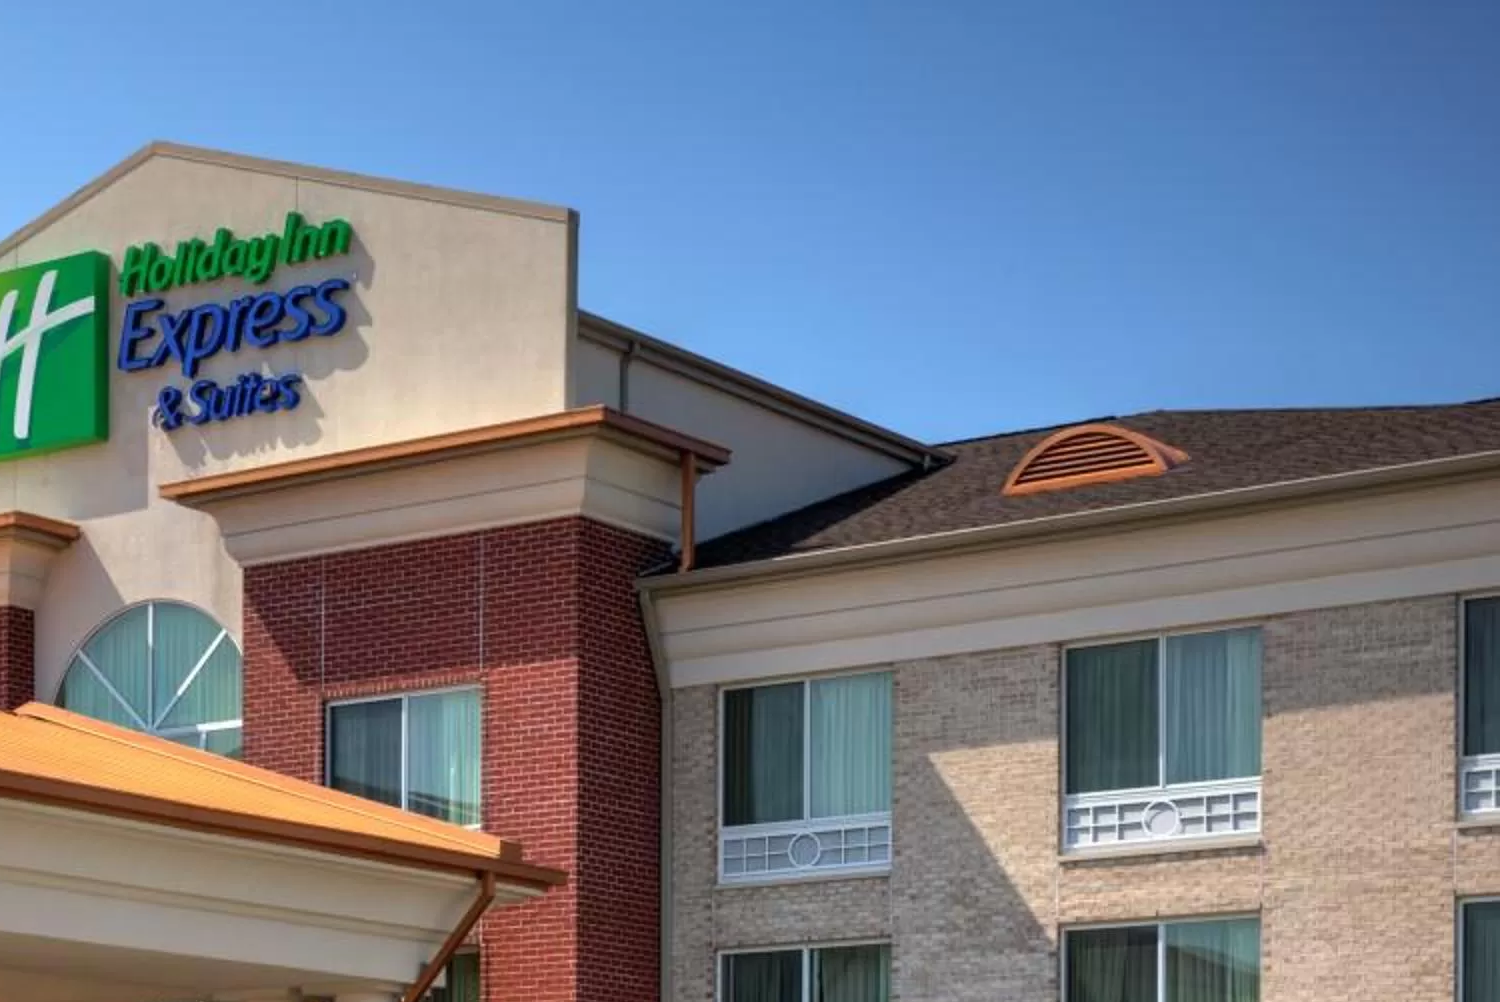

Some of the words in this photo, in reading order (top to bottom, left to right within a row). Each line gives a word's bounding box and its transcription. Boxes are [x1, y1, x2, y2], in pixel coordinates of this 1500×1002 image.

[117, 278, 349, 377] Express
[152, 385, 184, 431] &
[188, 371, 301, 424] Suites
